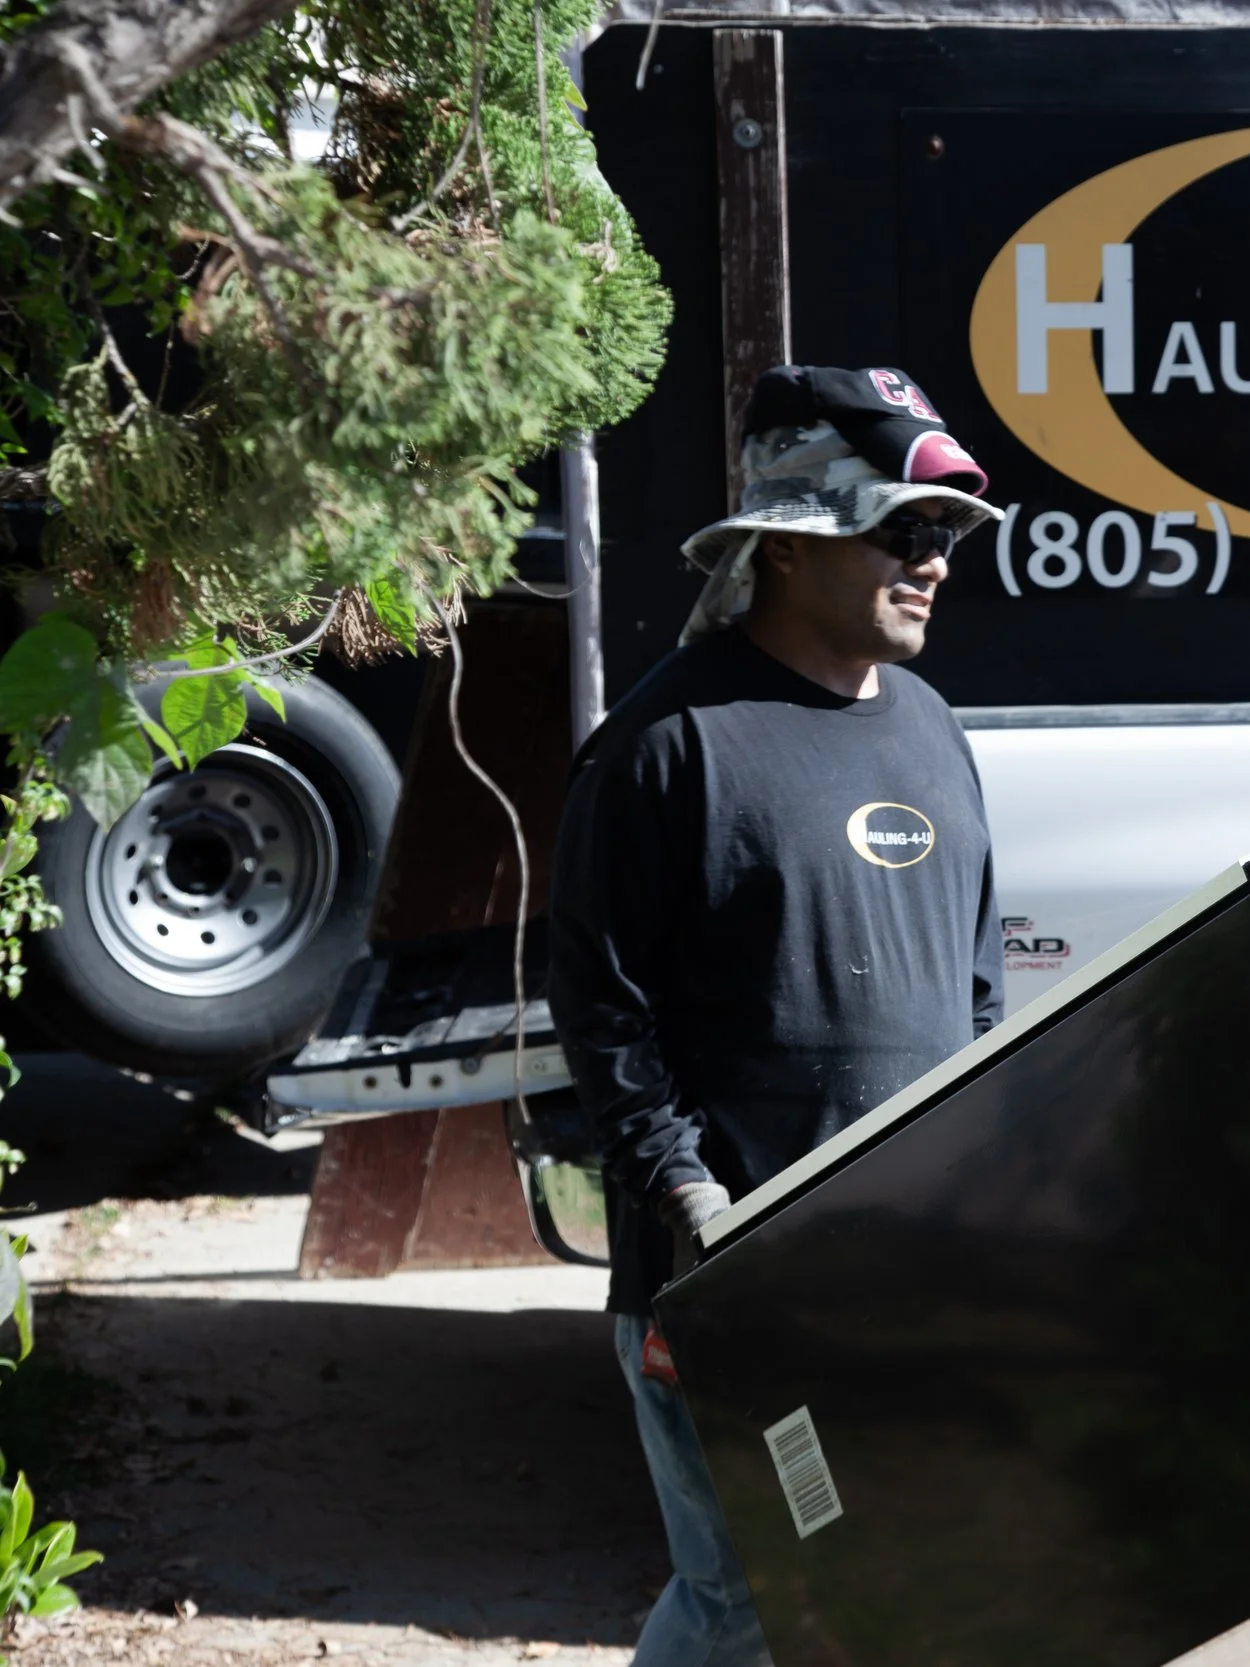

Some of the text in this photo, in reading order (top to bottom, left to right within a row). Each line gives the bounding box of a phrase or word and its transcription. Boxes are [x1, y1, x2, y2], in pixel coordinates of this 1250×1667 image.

[996, 501, 1231, 597] (805)
[1004, 938, 1070, 957] AD
[1005, 961, 1062, 971] LOPMENT
